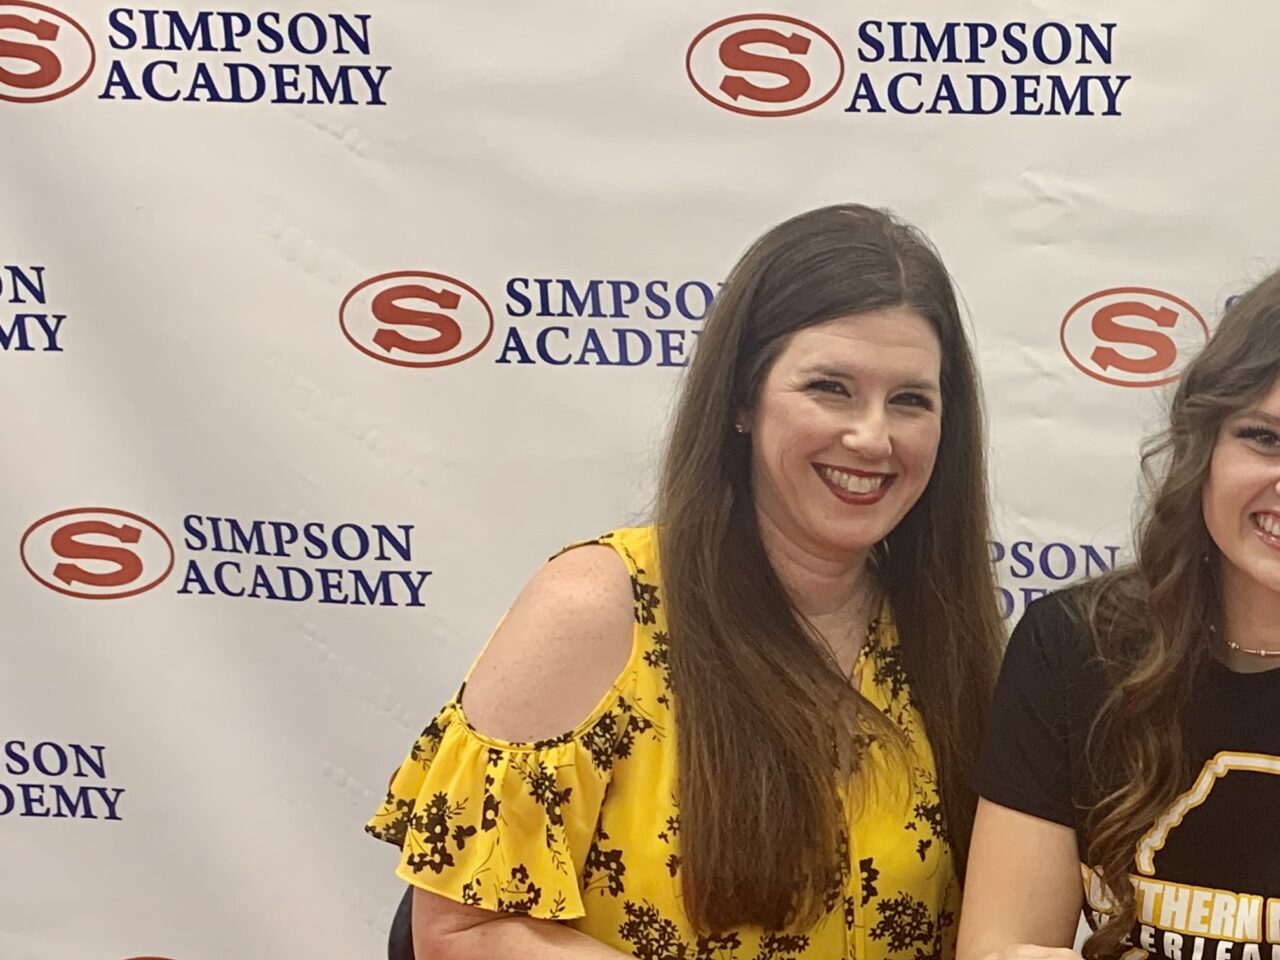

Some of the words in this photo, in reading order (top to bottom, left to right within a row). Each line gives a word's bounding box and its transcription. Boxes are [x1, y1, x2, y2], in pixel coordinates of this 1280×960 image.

[107, 8, 371, 55] SIMPSON
[857, 20, 1118, 64] SIMPSON
[98, 60, 392, 105] ACADEMY
[844, 72, 1132, 117] ACADEMY
[505, 277, 720, 321] SIMPSO
[495, 326, 704, 368] ACADE
[183, 514, 415, 562] SIMPSON
[176, 559, 433, 607] ACADEMY
